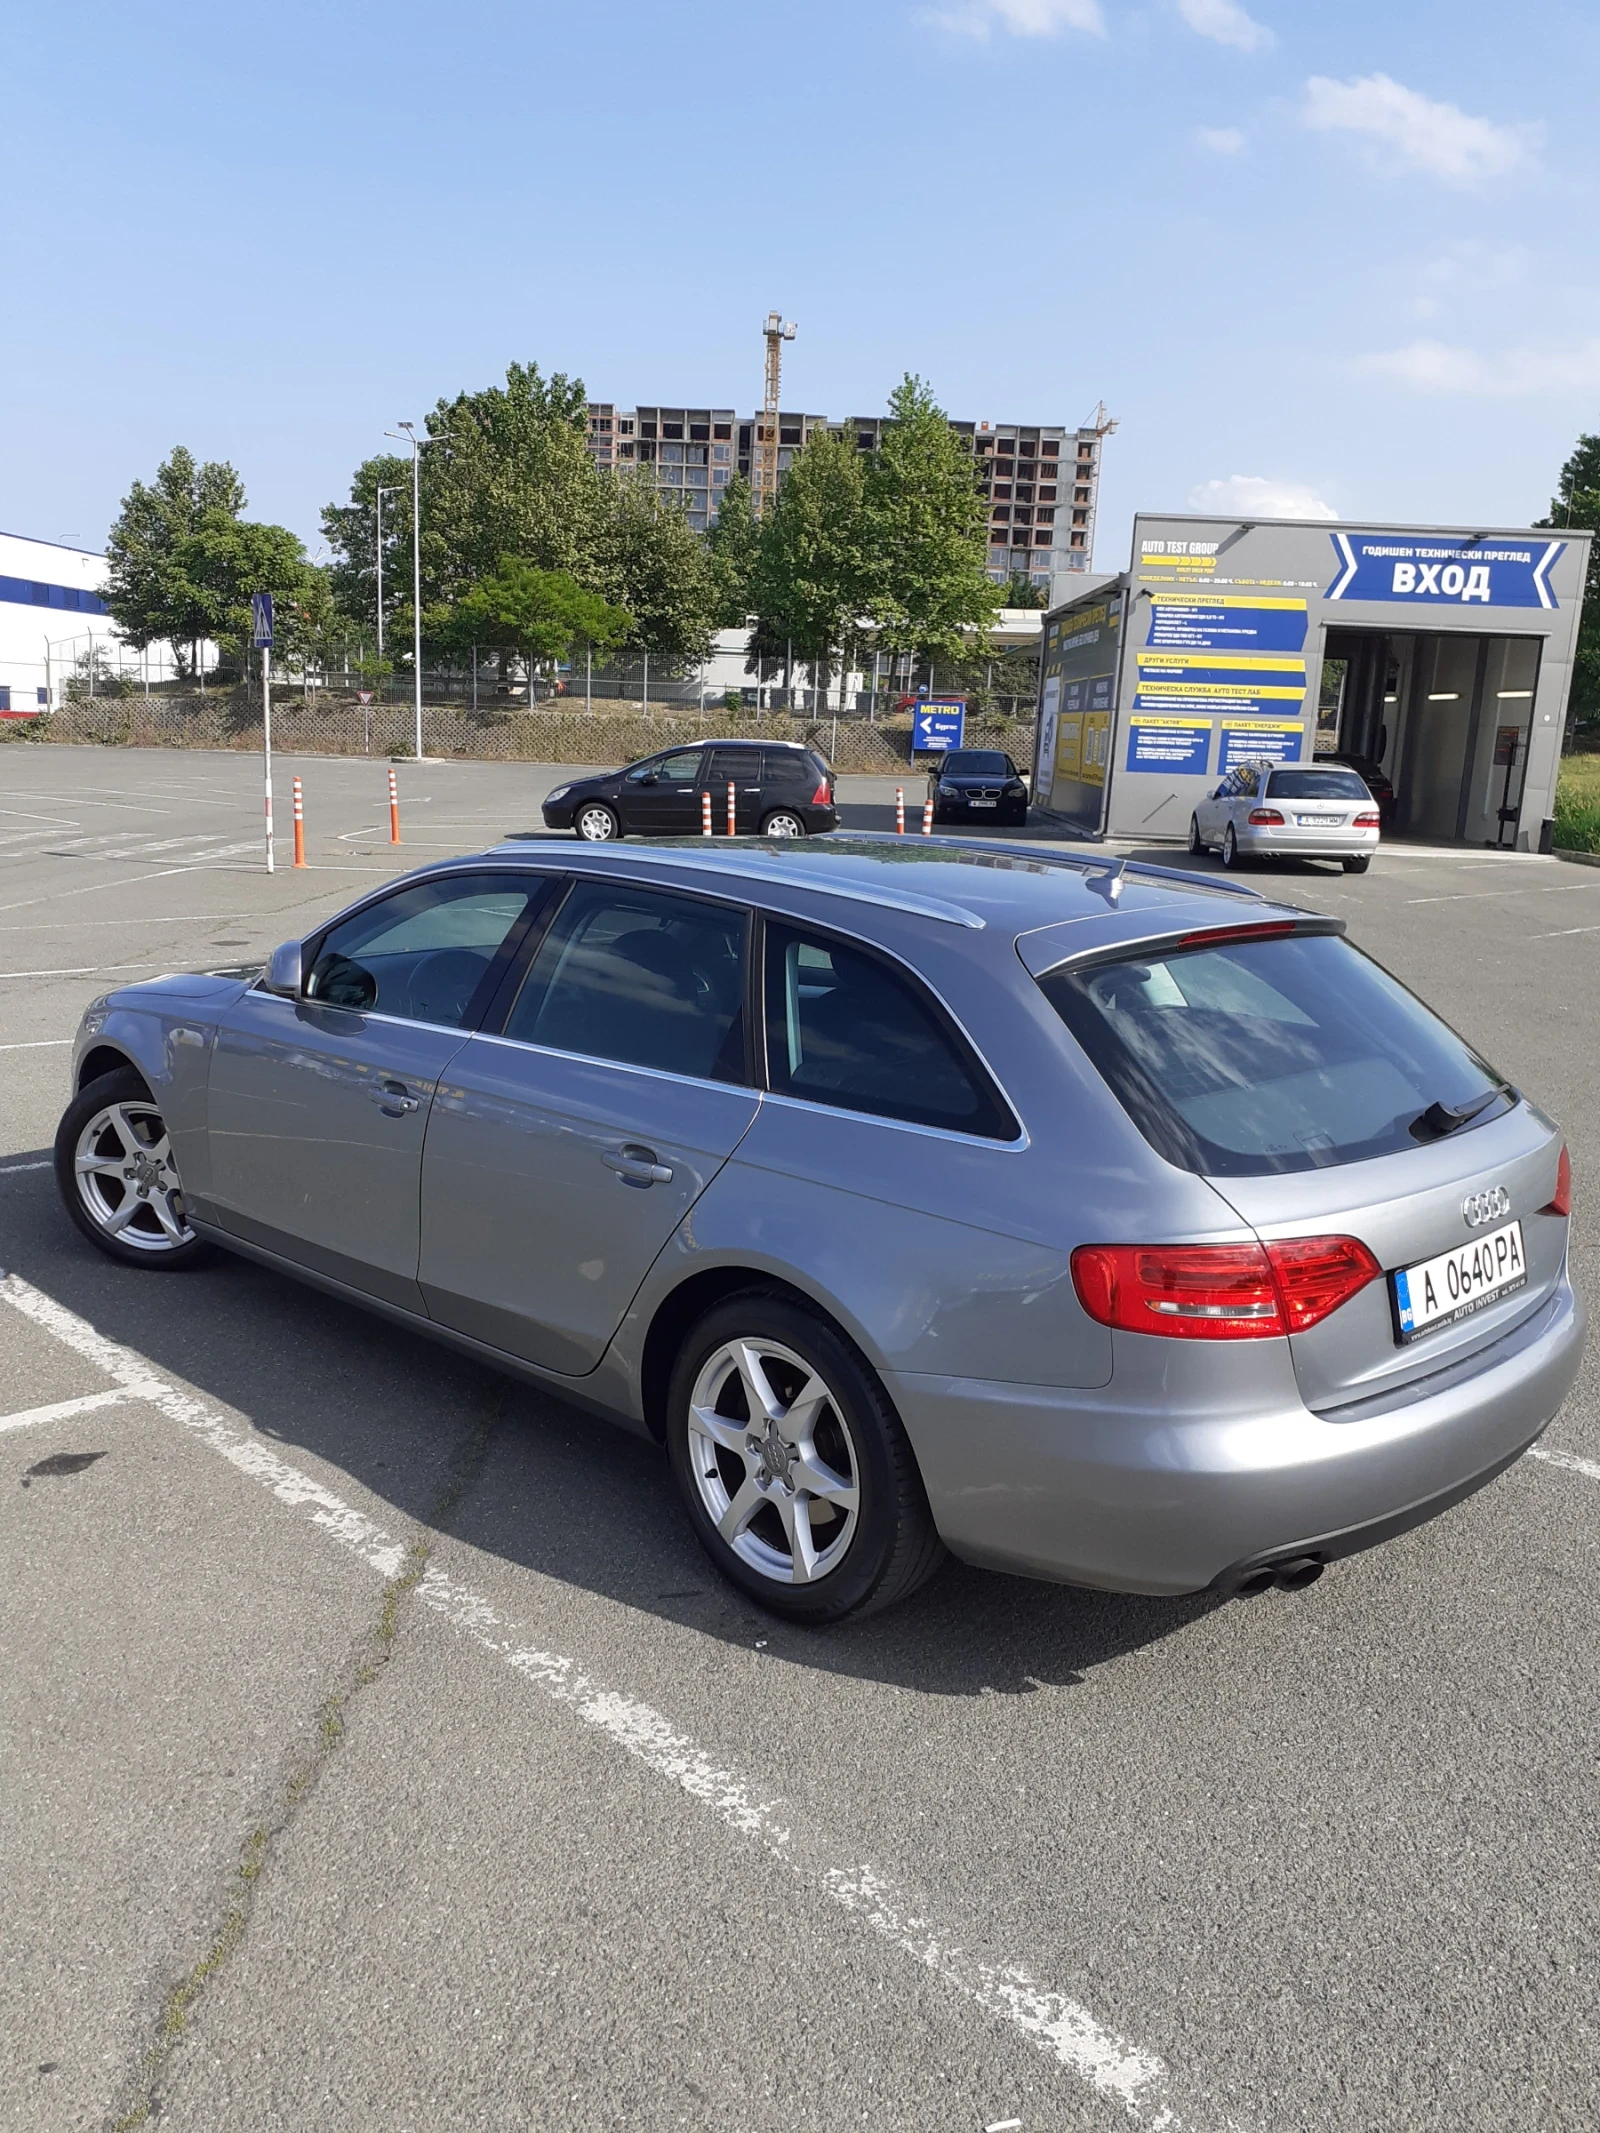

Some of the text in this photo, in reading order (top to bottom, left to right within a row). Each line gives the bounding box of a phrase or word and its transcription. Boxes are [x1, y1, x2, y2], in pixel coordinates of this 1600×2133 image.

[1142, 540, 1219, 554] AUTO TEST GROUP
[1362, 546, 1530, 563] ГОДИШЕН ТЕХНИЧЕСКИ ПРЕГЛЕД
[1392, 563, 1490, 601] ВХОД
[920, 705, 959, 714] METRO
[1425, 1230, 1521, 1314] A 0640 PA
[1454, 1289, 1500, 1321] AUTO INVEST
[1401, 1309, 1412, 1323] BG
